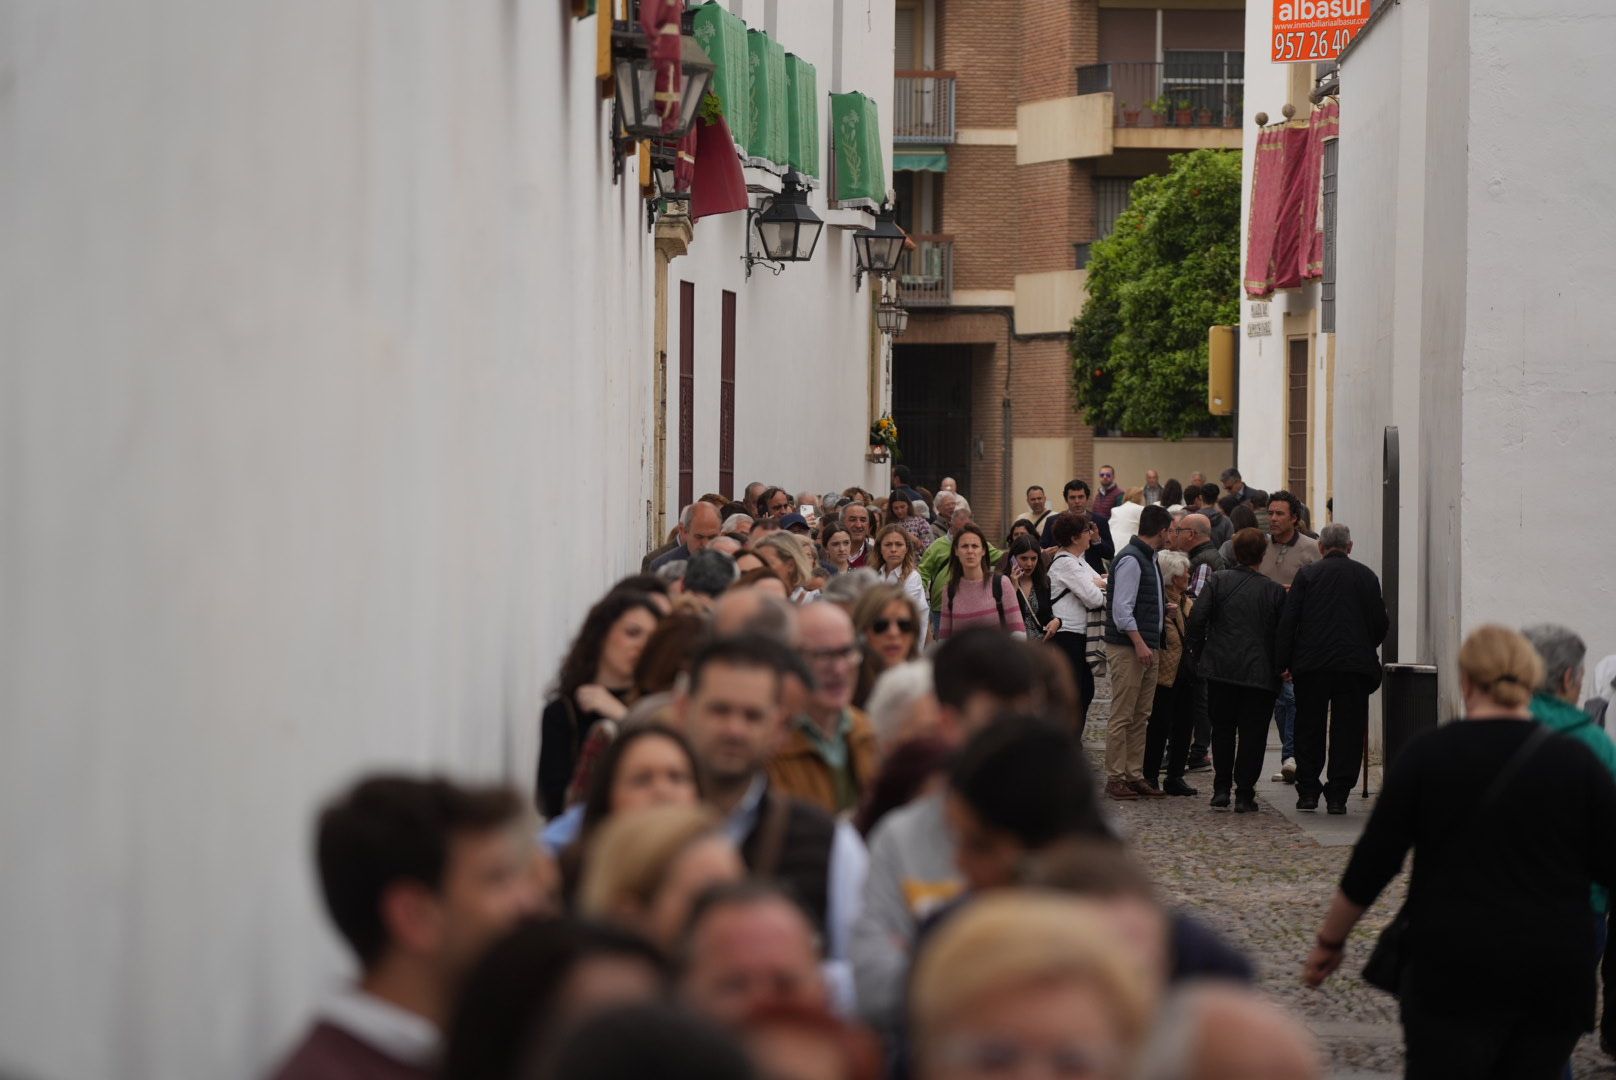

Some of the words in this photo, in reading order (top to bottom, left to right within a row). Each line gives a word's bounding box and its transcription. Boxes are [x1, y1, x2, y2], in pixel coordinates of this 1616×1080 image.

[1279, 0, 1366, 21] albasur
[1275, 32, 1304, 59] 957
[1309, 31, 1328, 57] 26
[1332, 29, 1350, 56] 40
